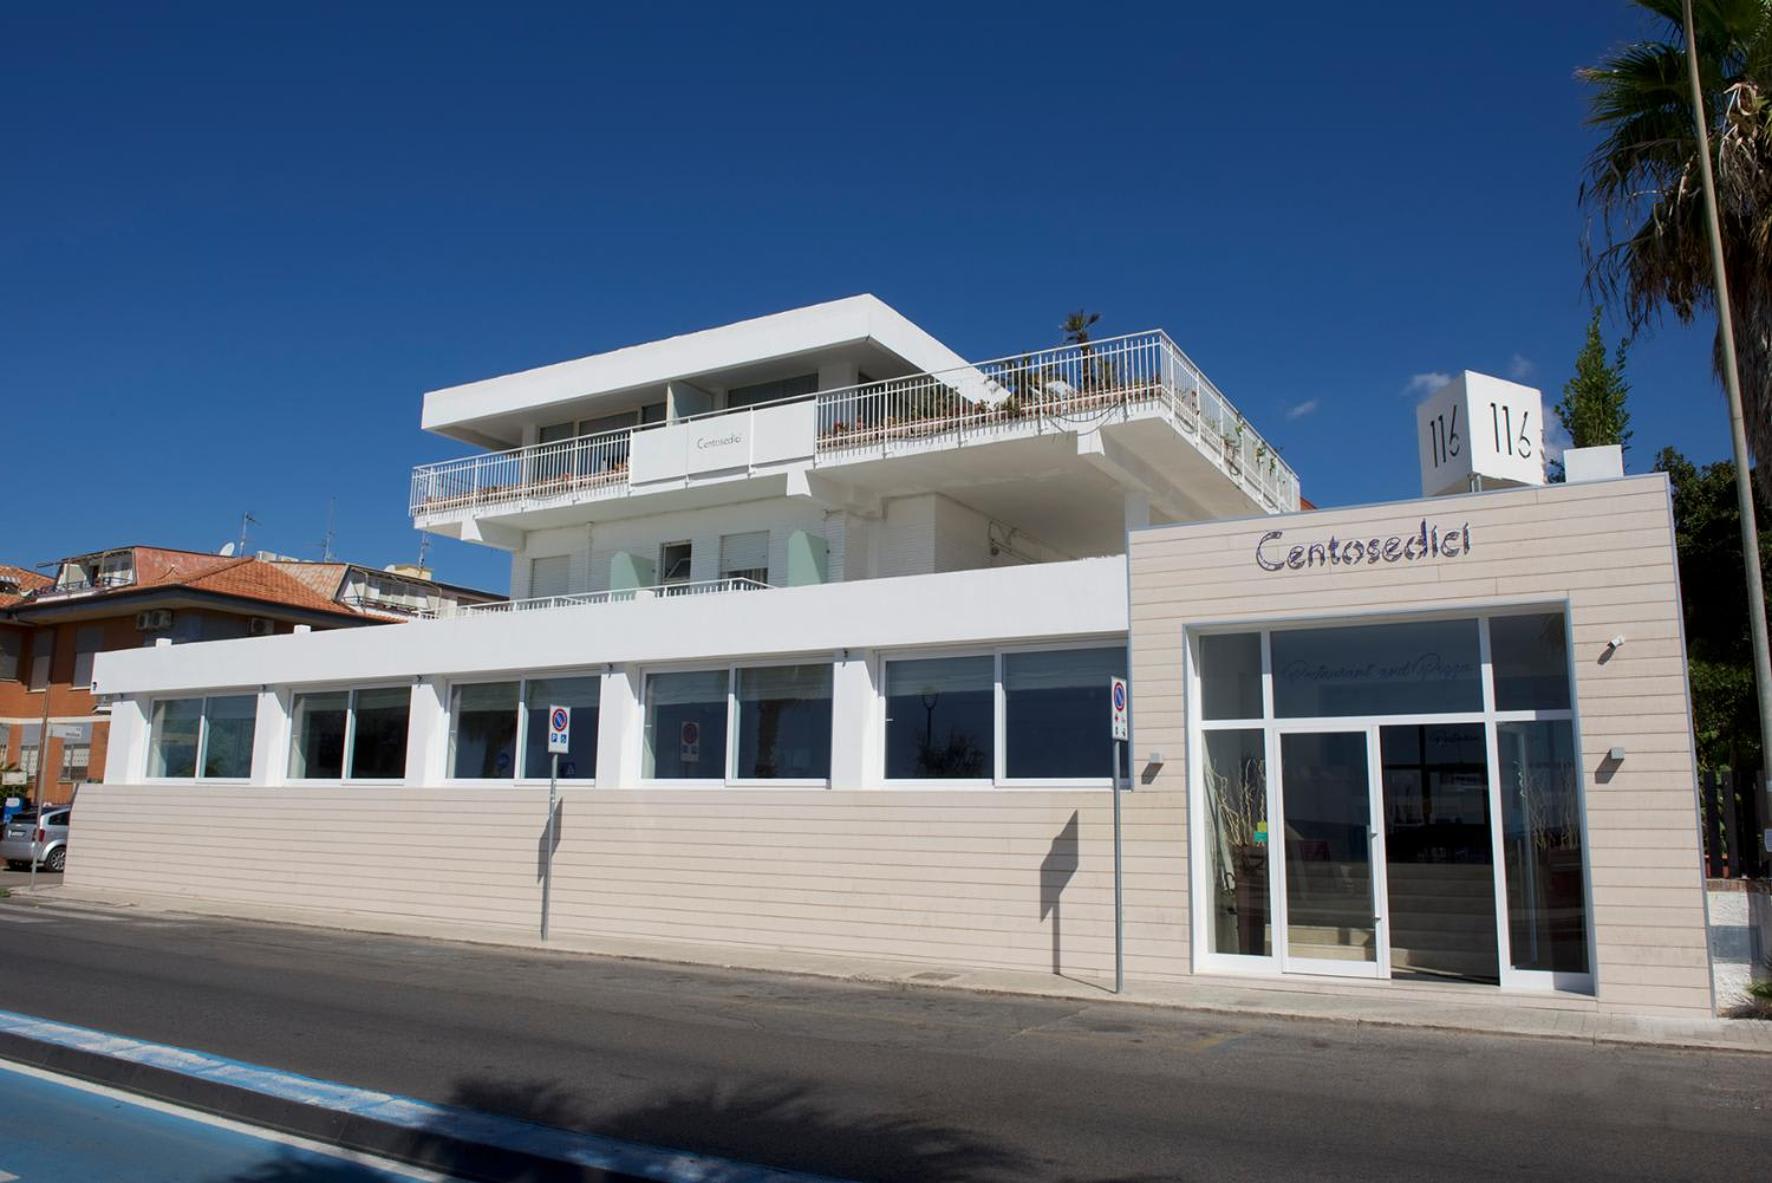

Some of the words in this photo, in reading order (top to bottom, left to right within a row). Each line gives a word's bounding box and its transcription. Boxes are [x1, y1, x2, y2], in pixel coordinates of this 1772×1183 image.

[1430, 404, 1460, 468] 116
[1490, 402, 1532, 459] 116
[1256, 518, 1471, 572] Centosedici
